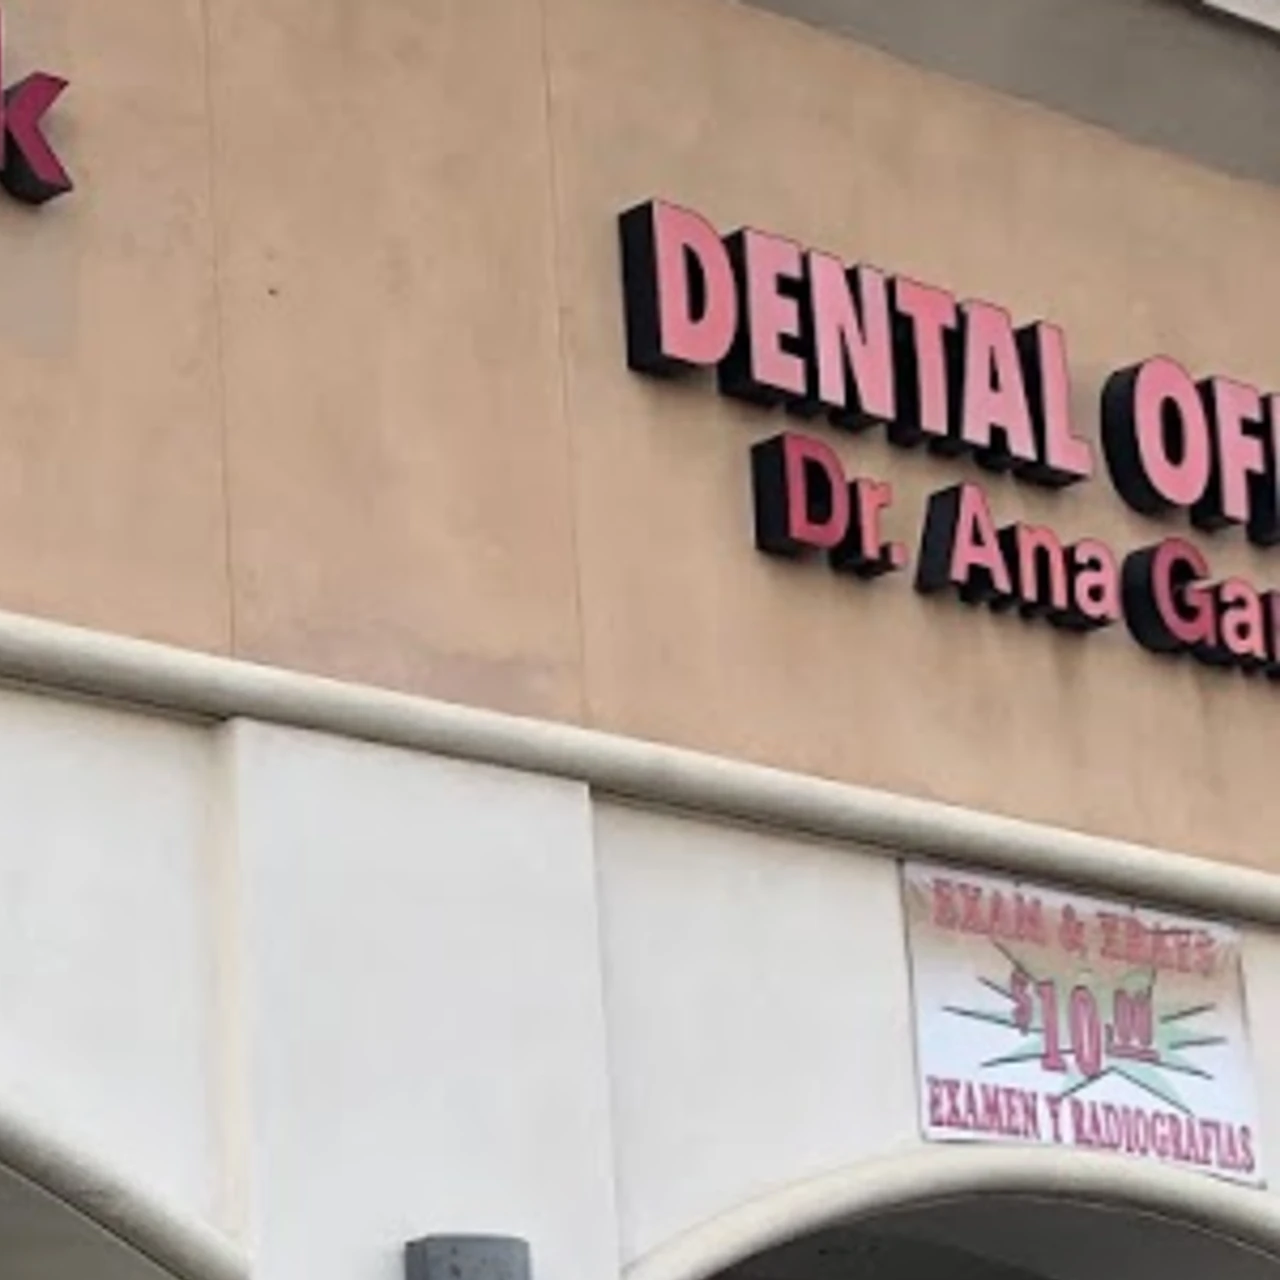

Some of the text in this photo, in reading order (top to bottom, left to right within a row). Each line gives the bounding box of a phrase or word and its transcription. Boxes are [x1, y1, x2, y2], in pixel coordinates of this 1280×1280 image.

[619, 199, 1280, 548] DENTAL OF
[751, 431, 1280, 678] Dr. Ana Ga
[933, 878, 1046, 949] EXAM
[927, 1076, 1040, 1138] EXAMEN
[1046, 1095, 1063, 1143] Y
